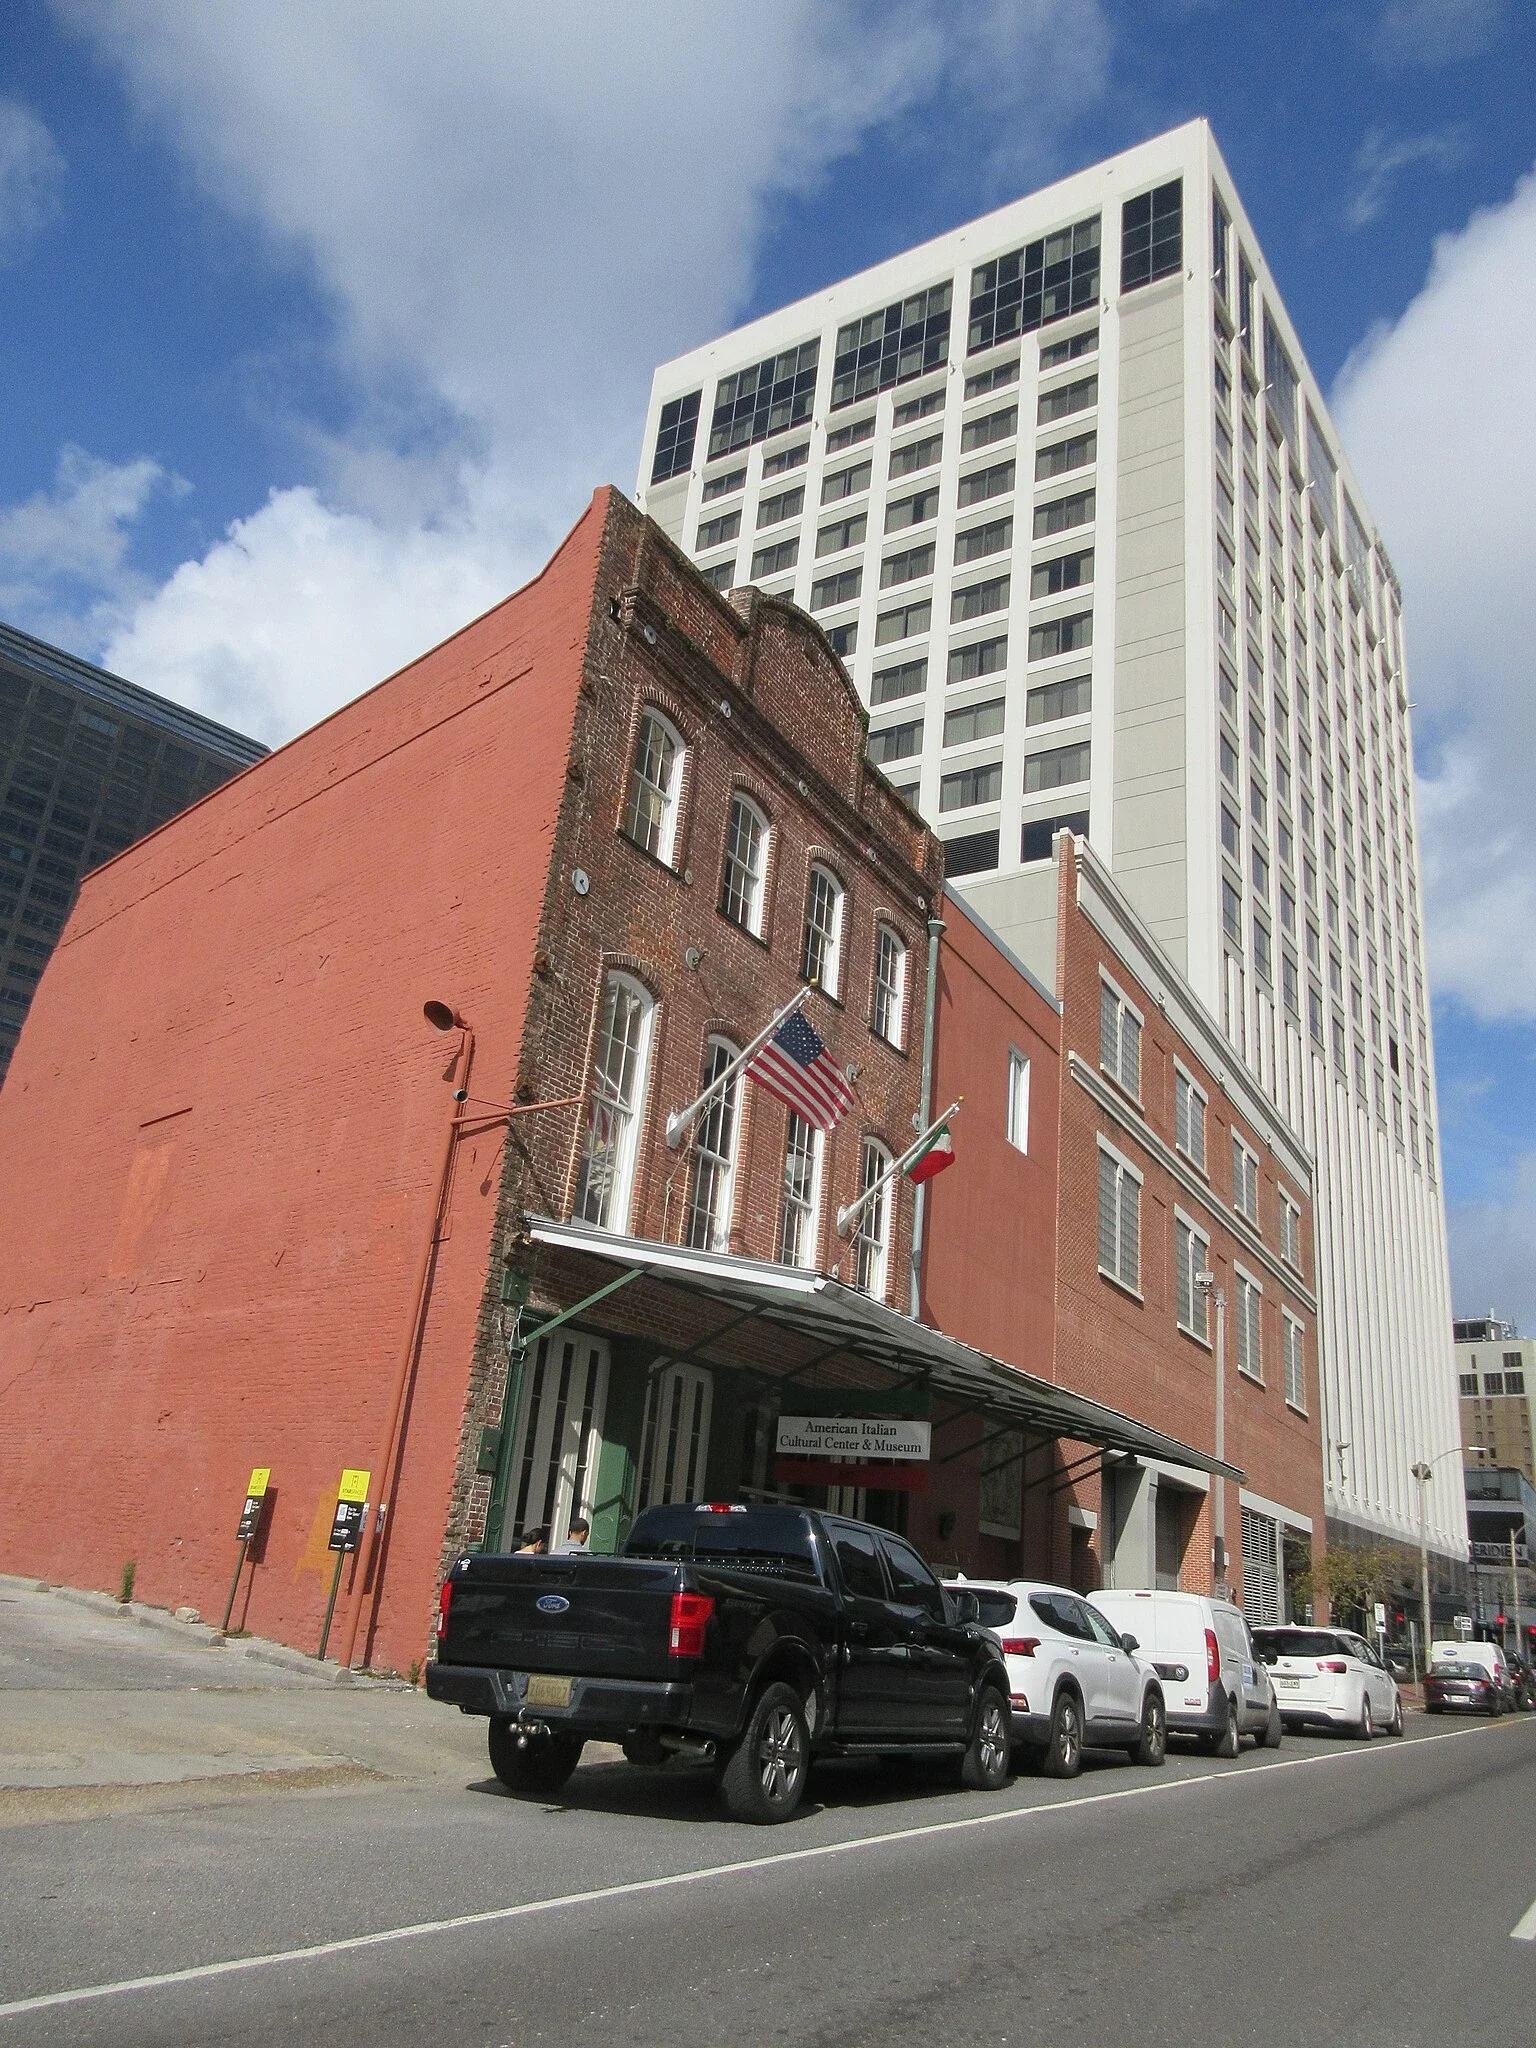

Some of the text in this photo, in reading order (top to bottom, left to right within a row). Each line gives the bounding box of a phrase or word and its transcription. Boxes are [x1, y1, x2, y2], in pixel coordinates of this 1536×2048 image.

[805, 1421, 897, 1436] American Italian
[780, 1435, 922, 1453] Cultural Center & Museum
[1474, 1544, 1522, 1557] ERIDIEN
